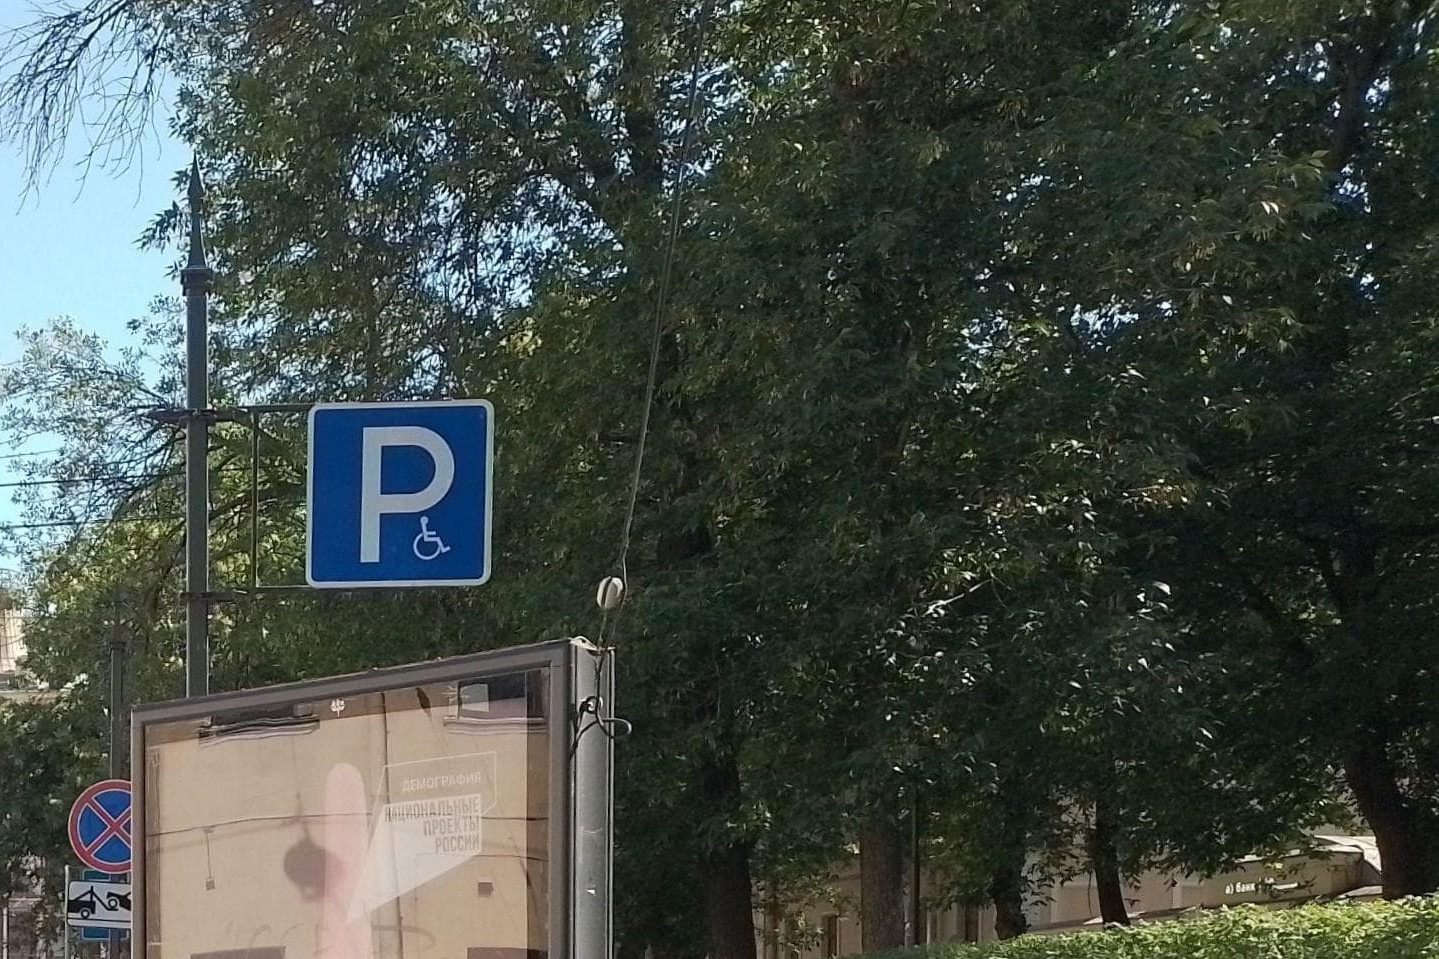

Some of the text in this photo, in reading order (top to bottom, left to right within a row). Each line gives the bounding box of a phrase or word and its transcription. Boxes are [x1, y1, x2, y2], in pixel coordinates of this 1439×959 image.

[360, 426, 455, 563] P
[402, 771, 482, 793] ДЕМОГРАФИЯ
[384, 798, 480, 822] НАЦИОНАЛЬНЫЕ
[423, 816, 480, 836] ПРОЕКТЫ
[434, 836, 480, 854] РОССИИ
